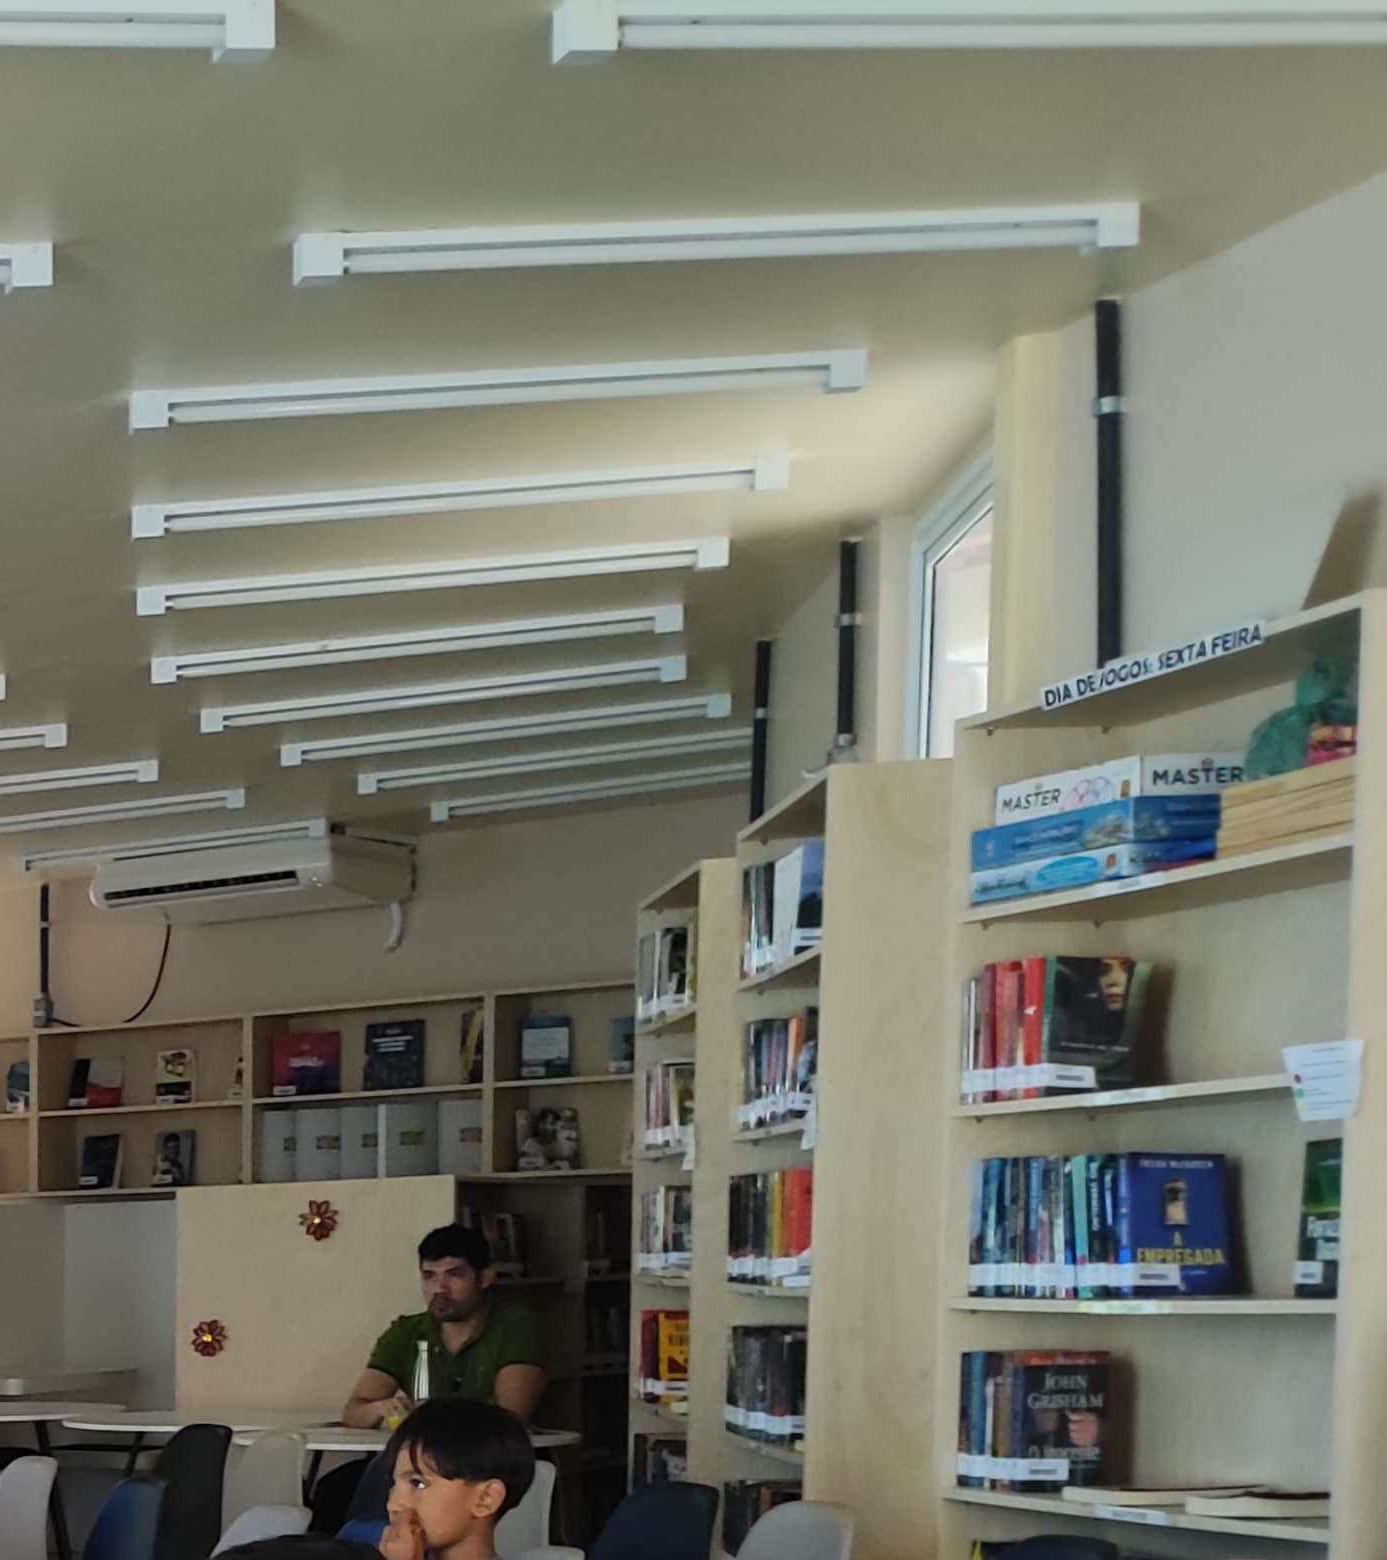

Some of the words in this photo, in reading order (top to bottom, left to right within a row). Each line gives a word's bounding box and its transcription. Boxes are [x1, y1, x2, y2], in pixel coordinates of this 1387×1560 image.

[1044, 684, 1073, 707] DIA
[1076, 675, 1097, 697] DE
[1158, 640, 1207, 671] SEXTA
[1211, 623, 1263, 655] FEIRA
[1152, 766, 1245, 787] MASTER
[1001, 788, 1061, 812] MASTER
